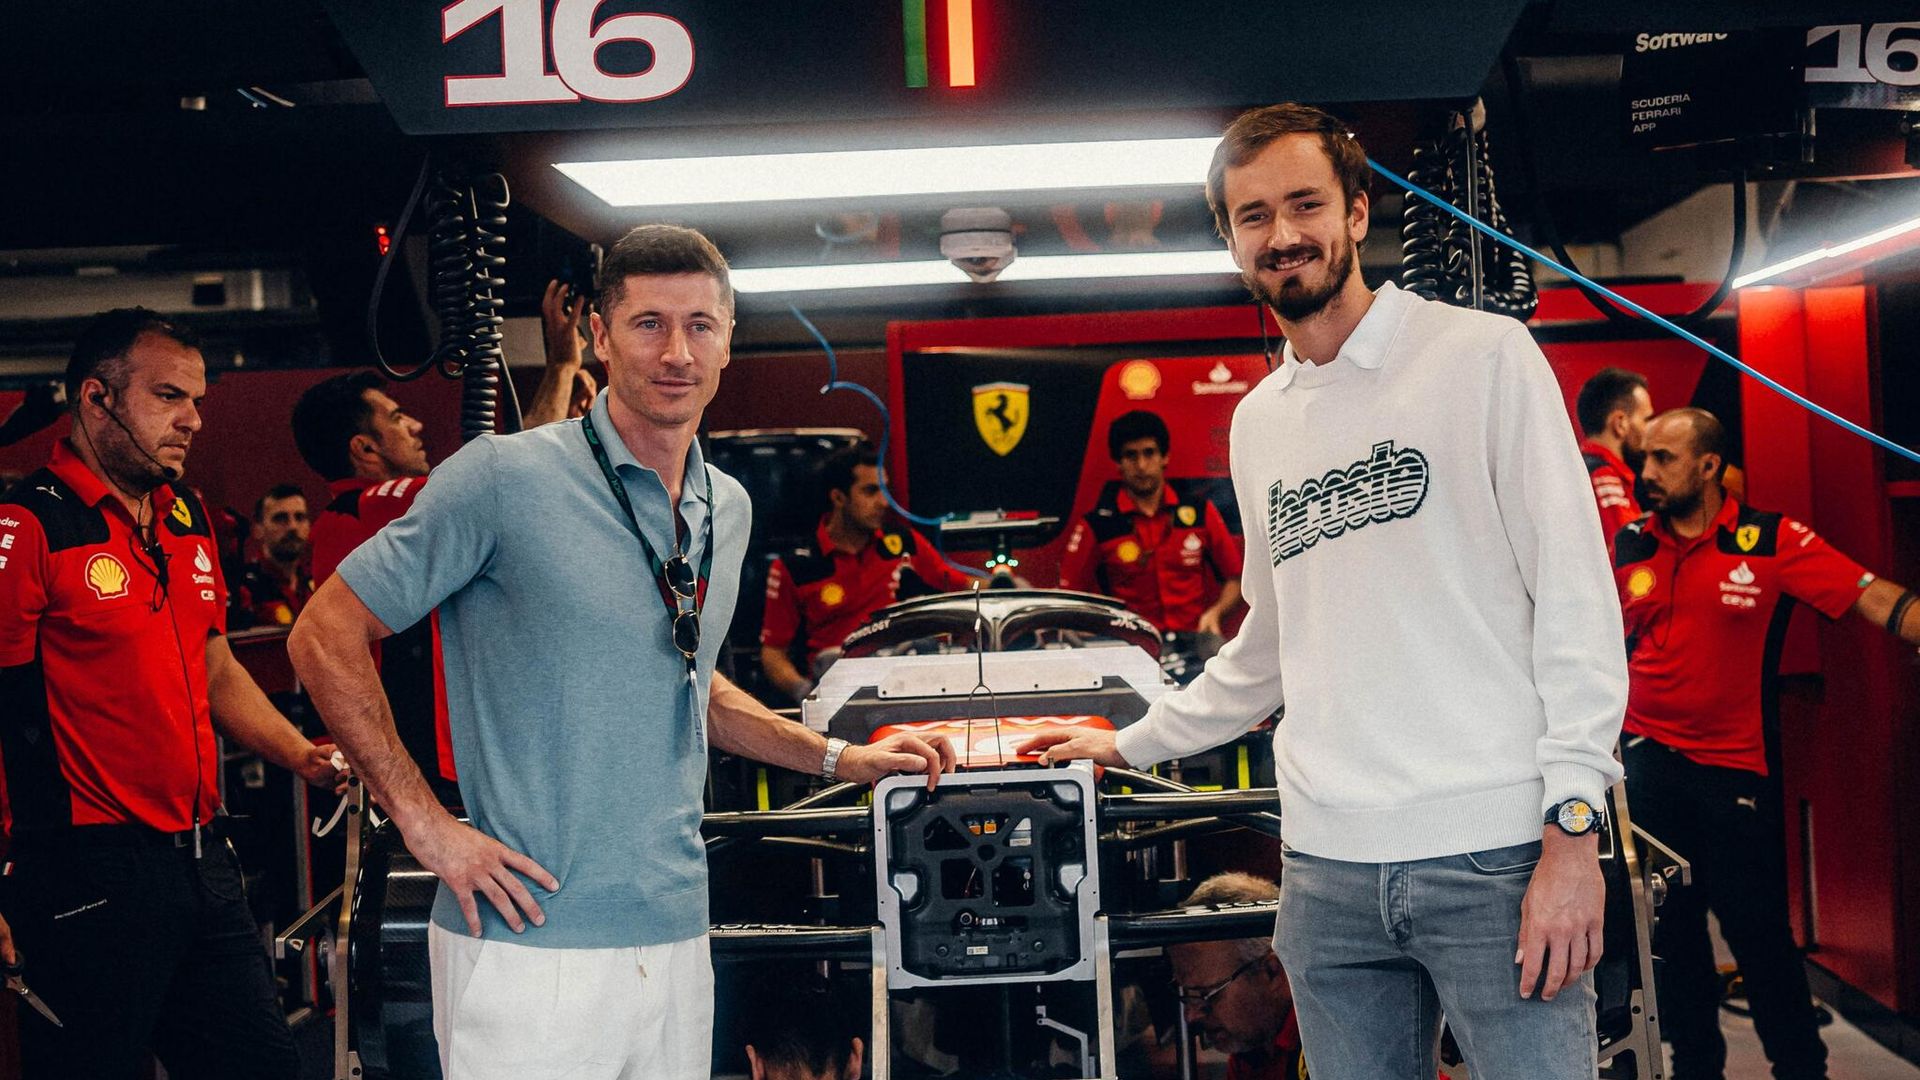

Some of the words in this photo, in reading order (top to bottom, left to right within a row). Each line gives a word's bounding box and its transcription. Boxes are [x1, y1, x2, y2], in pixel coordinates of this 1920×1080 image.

[441, 0, 696, 107] 16
[1804, 21, 1920, 87] 16
[1631, 93, 1691, 109] SCUDERIA
[1632, 107, 1681, 121] FERRARI
[1633, 122, 1656, 134] APP
